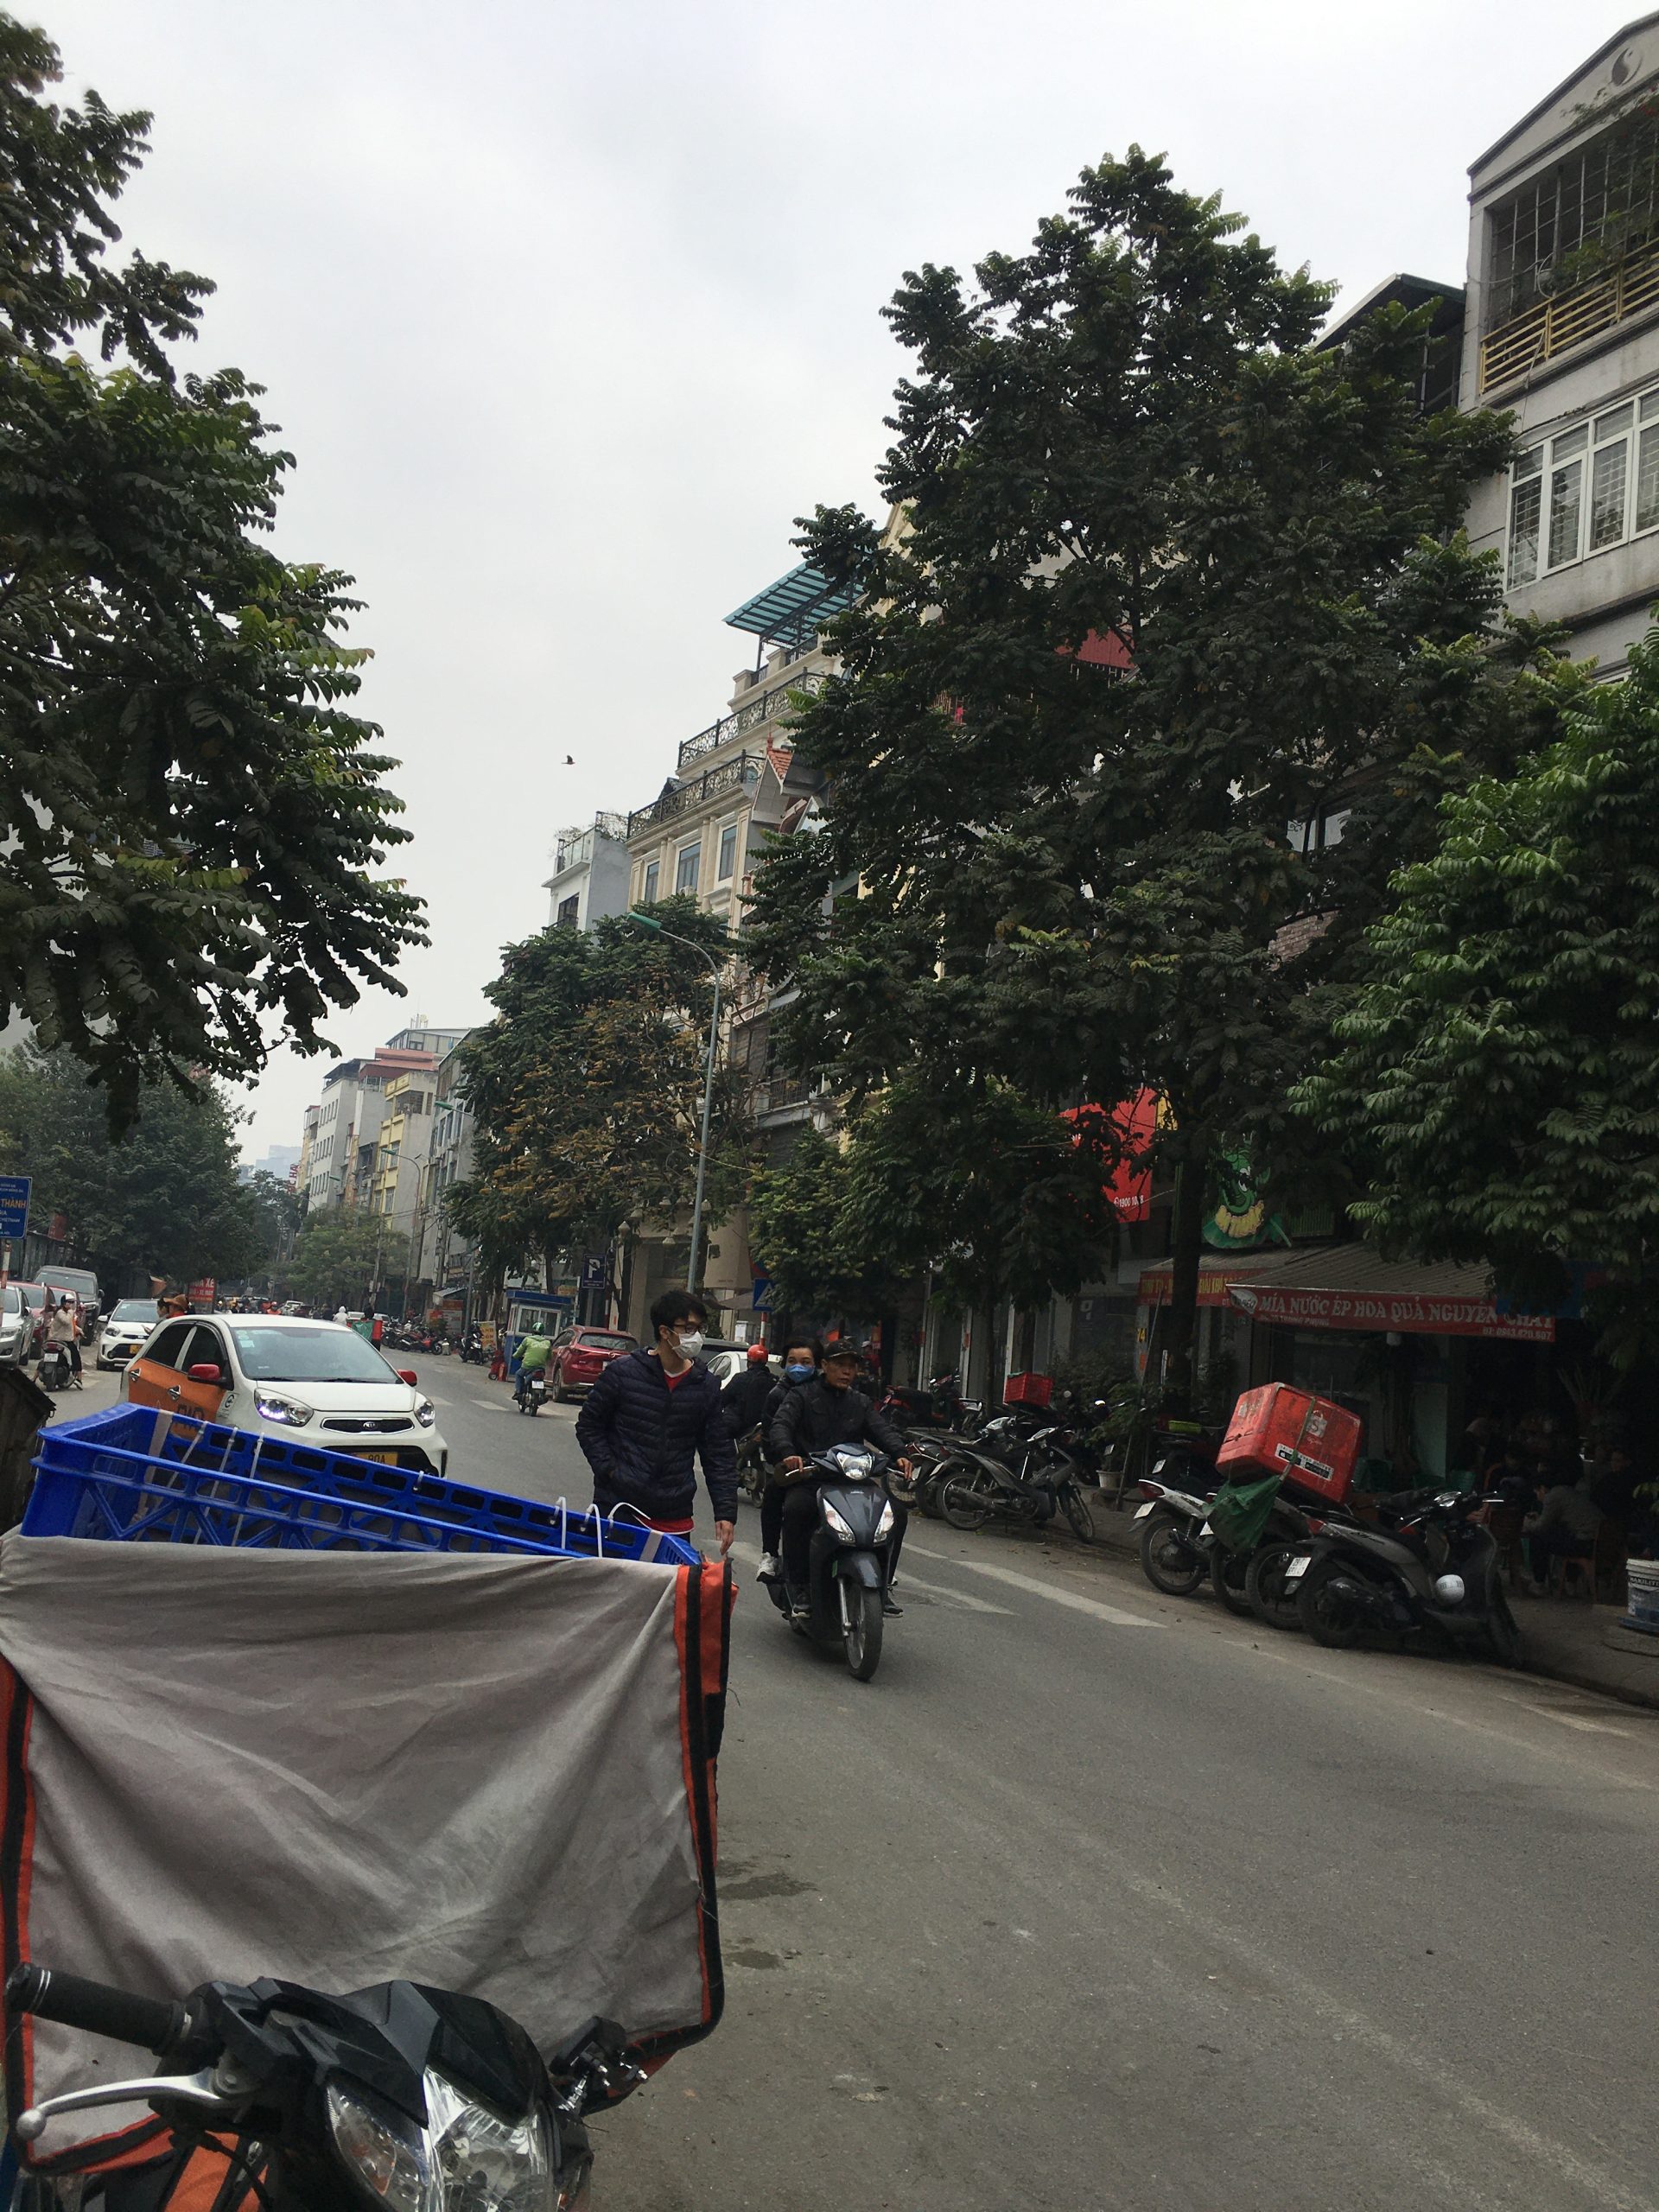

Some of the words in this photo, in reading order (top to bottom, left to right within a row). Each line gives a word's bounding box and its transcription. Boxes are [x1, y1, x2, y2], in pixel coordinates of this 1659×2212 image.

[1259, 1292, 1286, 1313] MÍA
[1290, 1294, 1330, 1315] NƯỚC
[1332, 1294, 1352, 1317] ÉP
[1353, 1300, 1387, 1319] HOA
[1391, 1295, 1425, 1323] QUẢ
[1428, 1300, 1497, 1325] NGUYÊN
